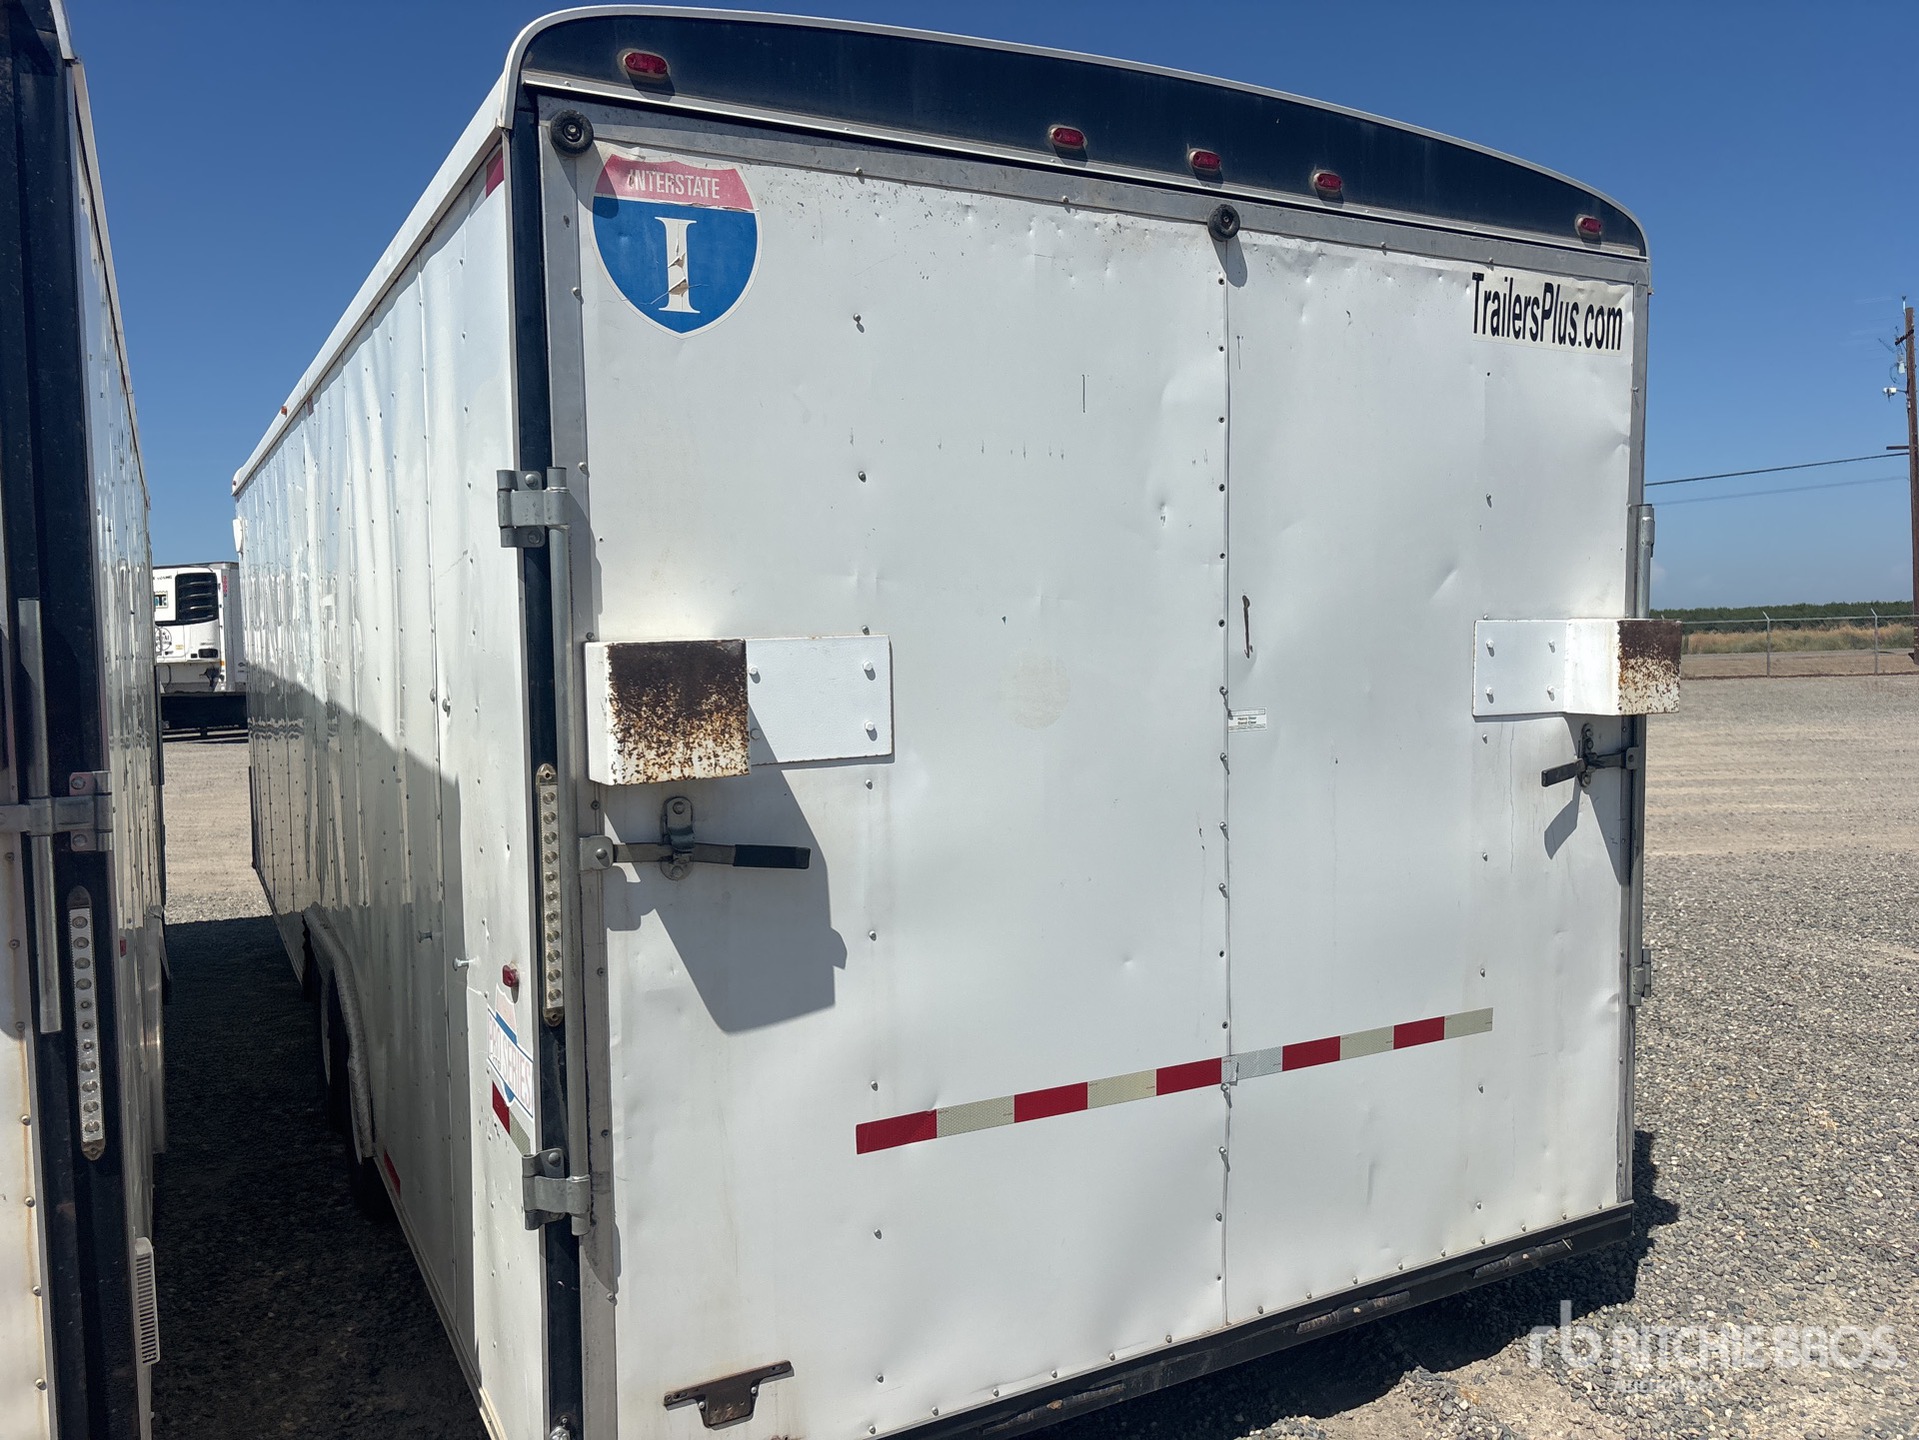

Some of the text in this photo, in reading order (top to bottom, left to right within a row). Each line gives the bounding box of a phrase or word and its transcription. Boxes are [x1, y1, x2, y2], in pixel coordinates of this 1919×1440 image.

[627, 169, 720, 199] INTERSTATE
[654, 217, 701, 314] I
[1471, 272, 1623, 351] TrailersPlus.com
[502, 1034, 531, 1110] SERIES
